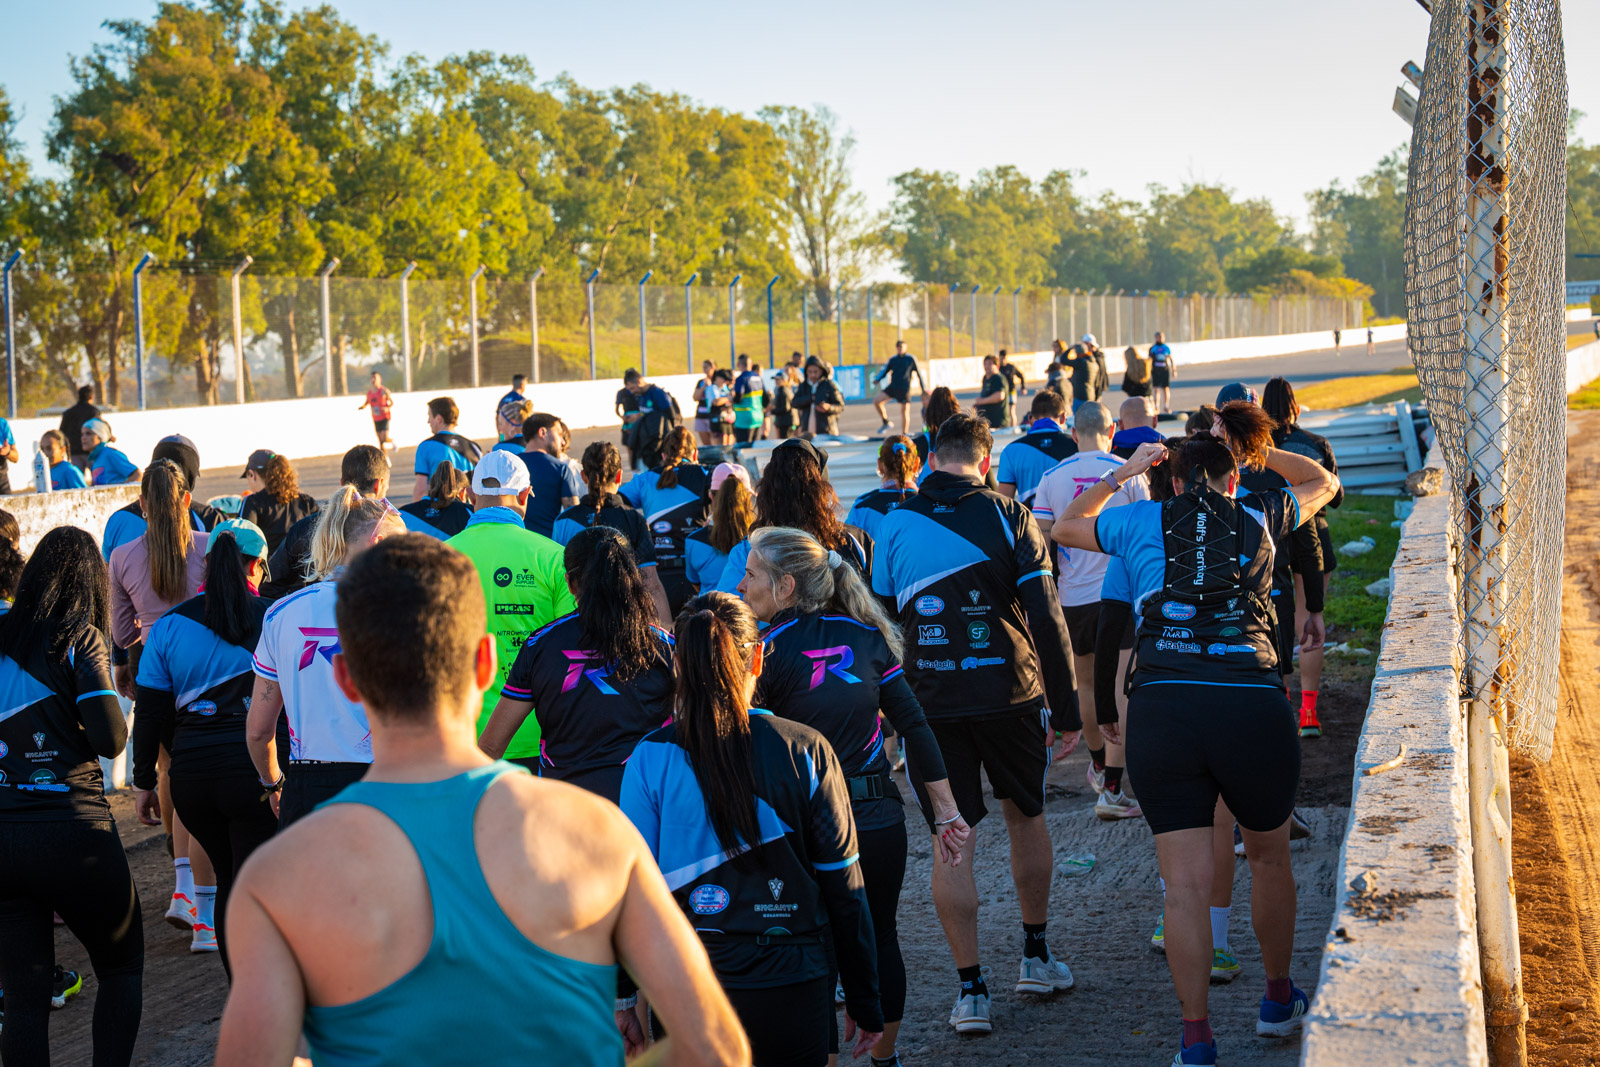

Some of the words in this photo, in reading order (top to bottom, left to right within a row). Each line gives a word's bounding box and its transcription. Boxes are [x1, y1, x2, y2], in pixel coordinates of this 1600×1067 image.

[1196, 512, 1207, 543] Wolf's
[1193, 545, 1207, 586] Territory
[918, 625, 946, 640] M&D
[971, 627, 985, 640] SF
[1166, 640, 1201, 650] Rafaela
